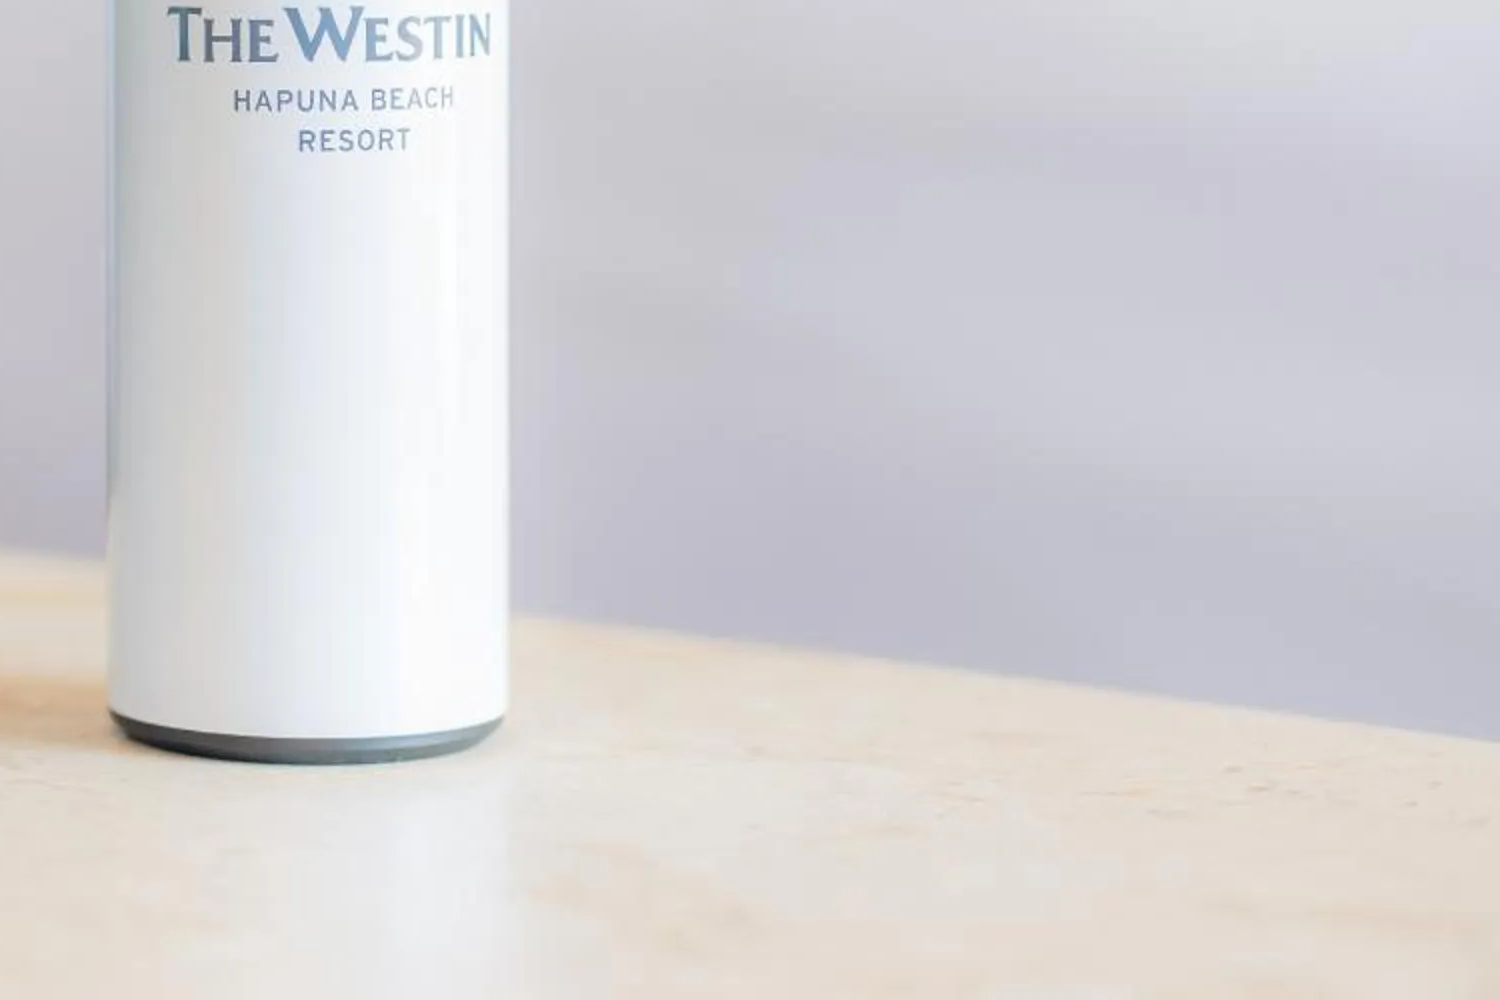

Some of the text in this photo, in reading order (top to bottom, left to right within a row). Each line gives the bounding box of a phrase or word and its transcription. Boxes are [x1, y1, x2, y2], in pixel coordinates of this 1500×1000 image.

[167, 5, 492, 63] THE WESTIN
[233, 86, 454, 113] HAPUNA BEACH
[298, 128, 411, 153] RESORT
